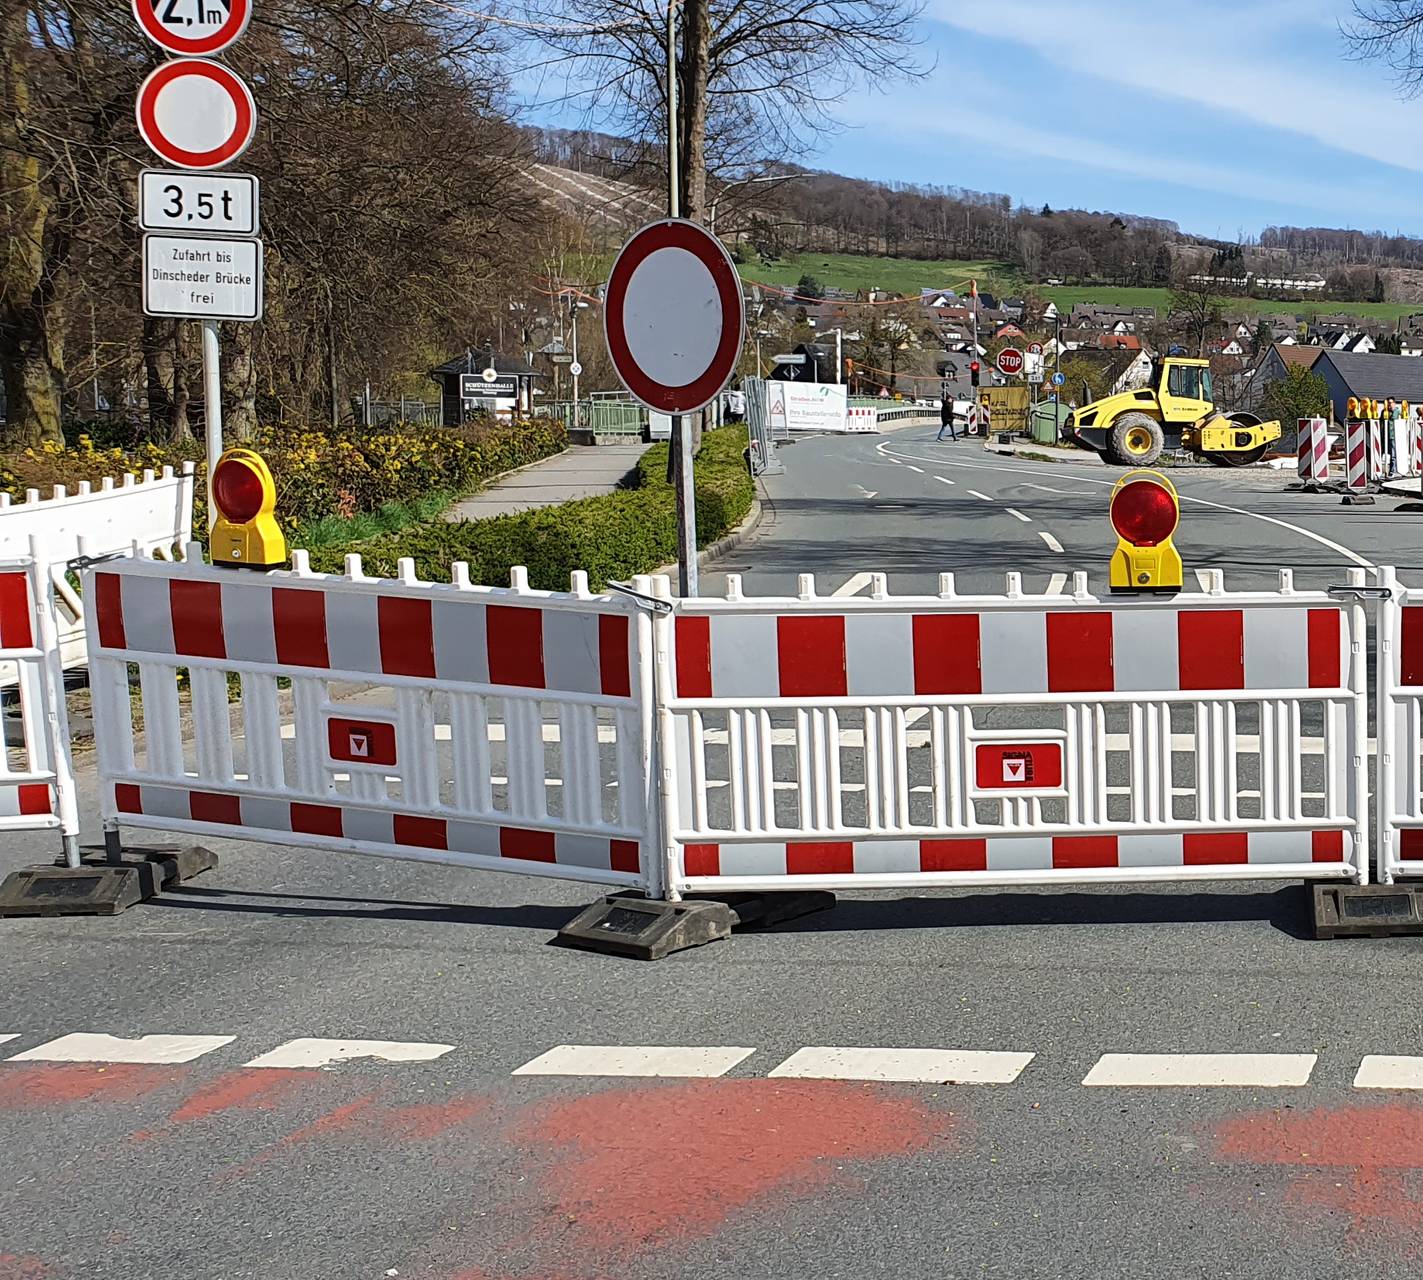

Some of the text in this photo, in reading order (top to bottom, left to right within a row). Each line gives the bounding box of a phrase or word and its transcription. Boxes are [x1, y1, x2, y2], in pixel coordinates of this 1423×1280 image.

[172, 248, 232, 263] Zufahrt bis
[152, 268, 251, 285] Dinscheder Brücke
[190, 291, 215, 304] frei
[999, 355, 1022, 367] STOP
